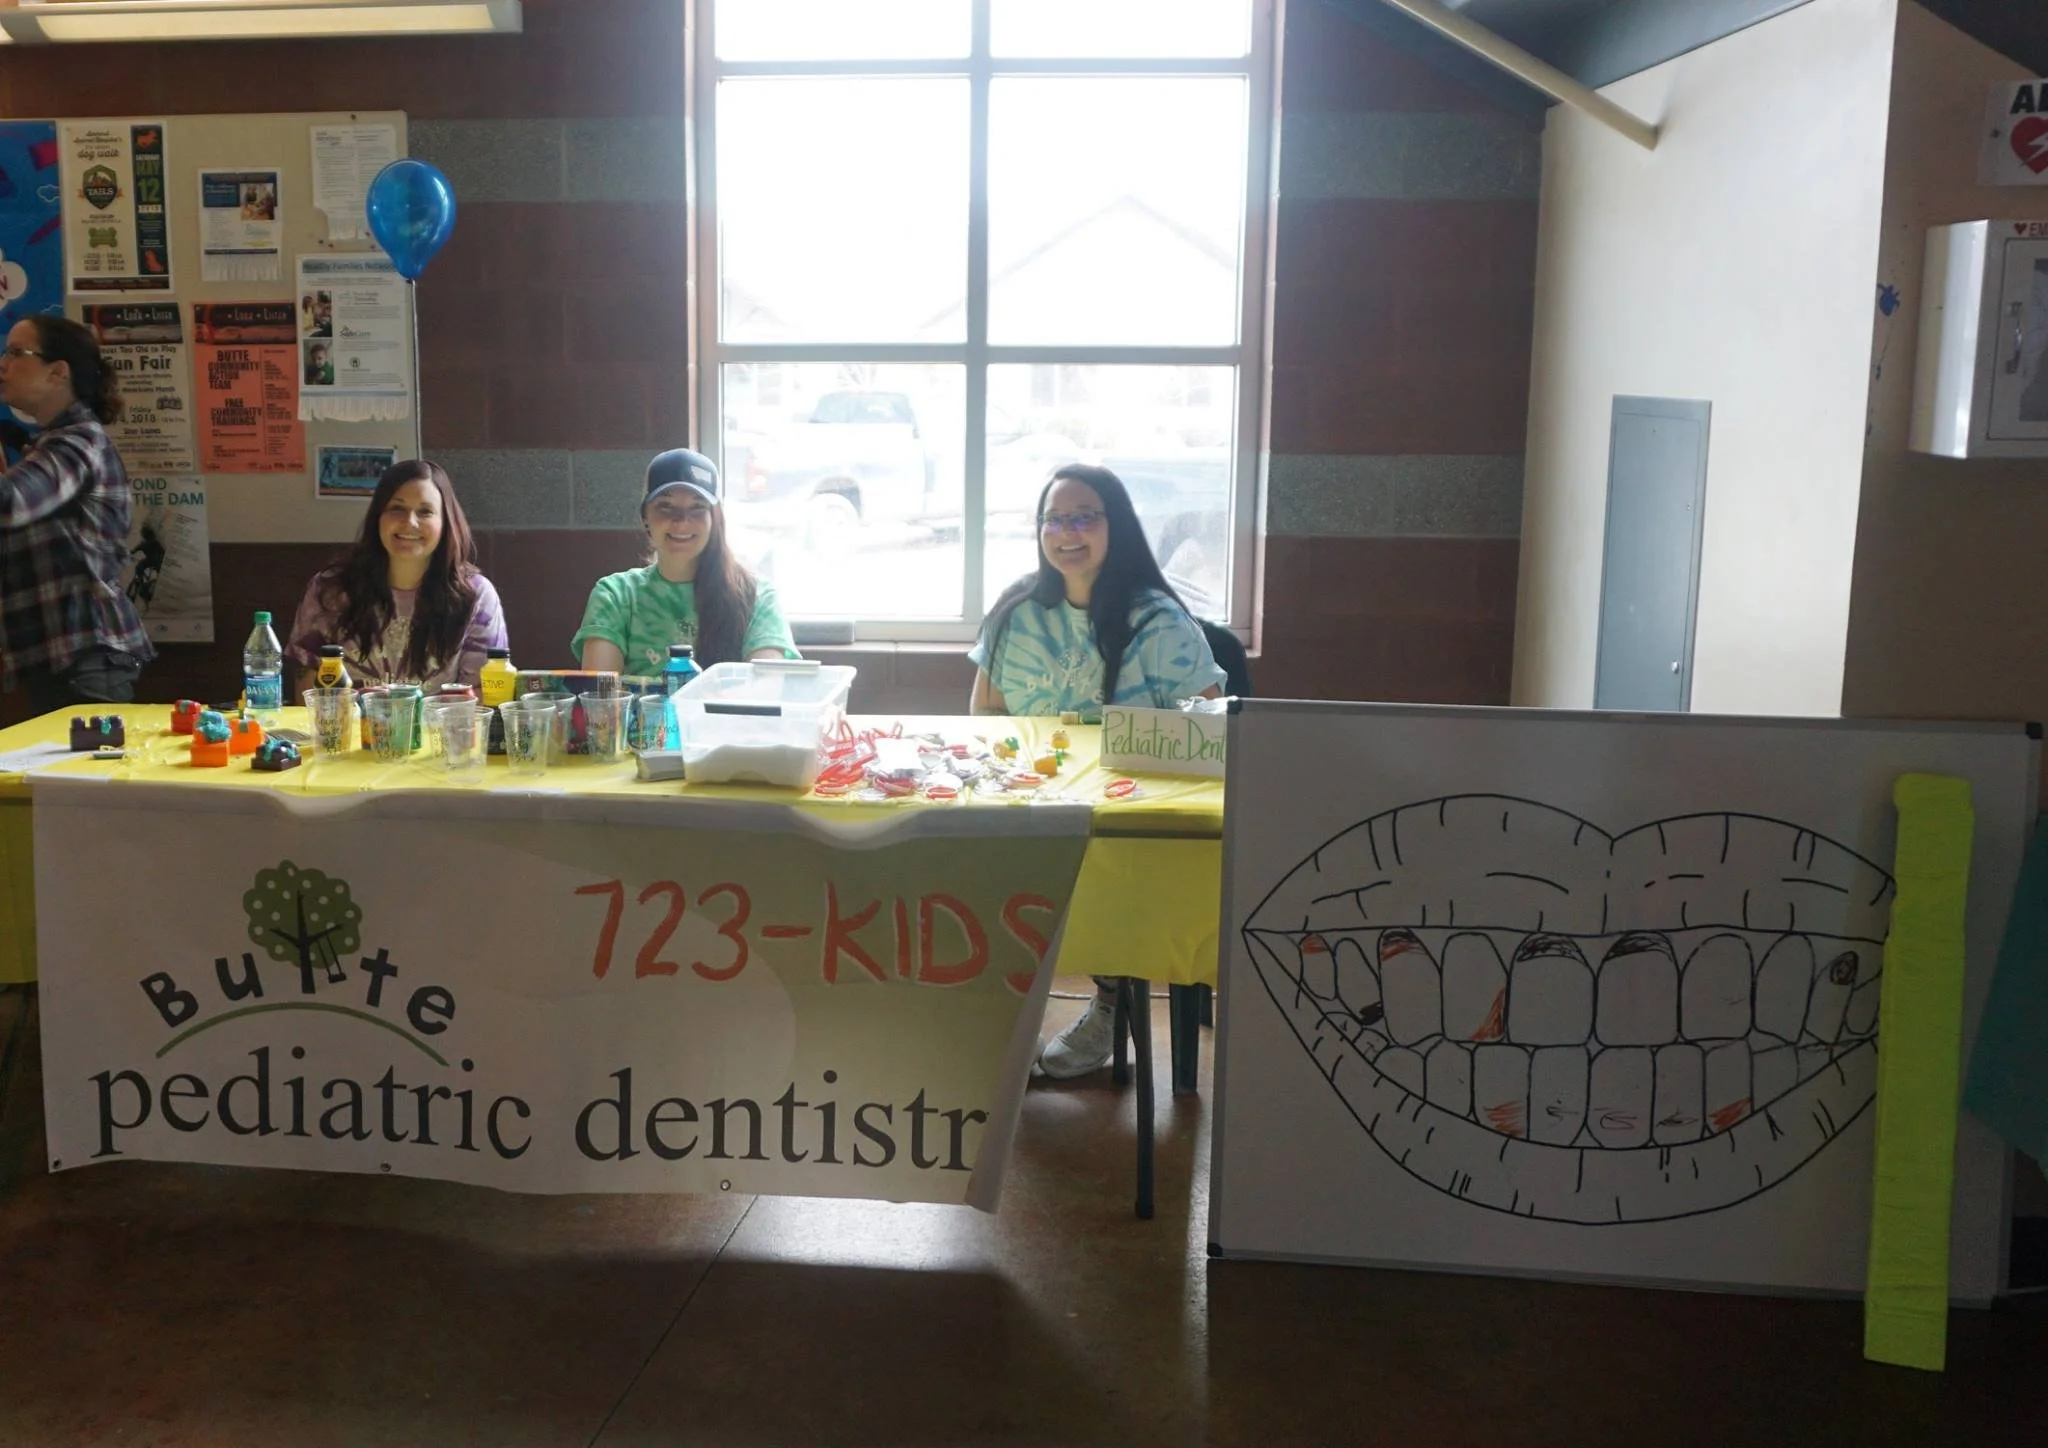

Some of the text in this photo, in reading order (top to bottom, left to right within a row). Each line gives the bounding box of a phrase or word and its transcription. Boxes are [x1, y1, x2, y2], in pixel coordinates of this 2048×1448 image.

[138, 177, 161, 202] 12
[218, 350, 249, 361] BUTTE
[140, 355, 172, 371] Fair
[208, 361, 260, 371] COMMUNITY
[209, 380, 232, 390] TEAM
[225, 398, 243, 407] FREE
[131, 414, 157, 423] 2018
[128, 477, 167, 490] OND
[132, 492, 204, 506] THE DAM
[1102, 711, 1226, 764] Pediatric Dent
[574, 878, 1056, 997] 723-KIDS
[140, 890, 456, 1036] Butte
[88, 1046, 990, 1172] pediatric dentistr
